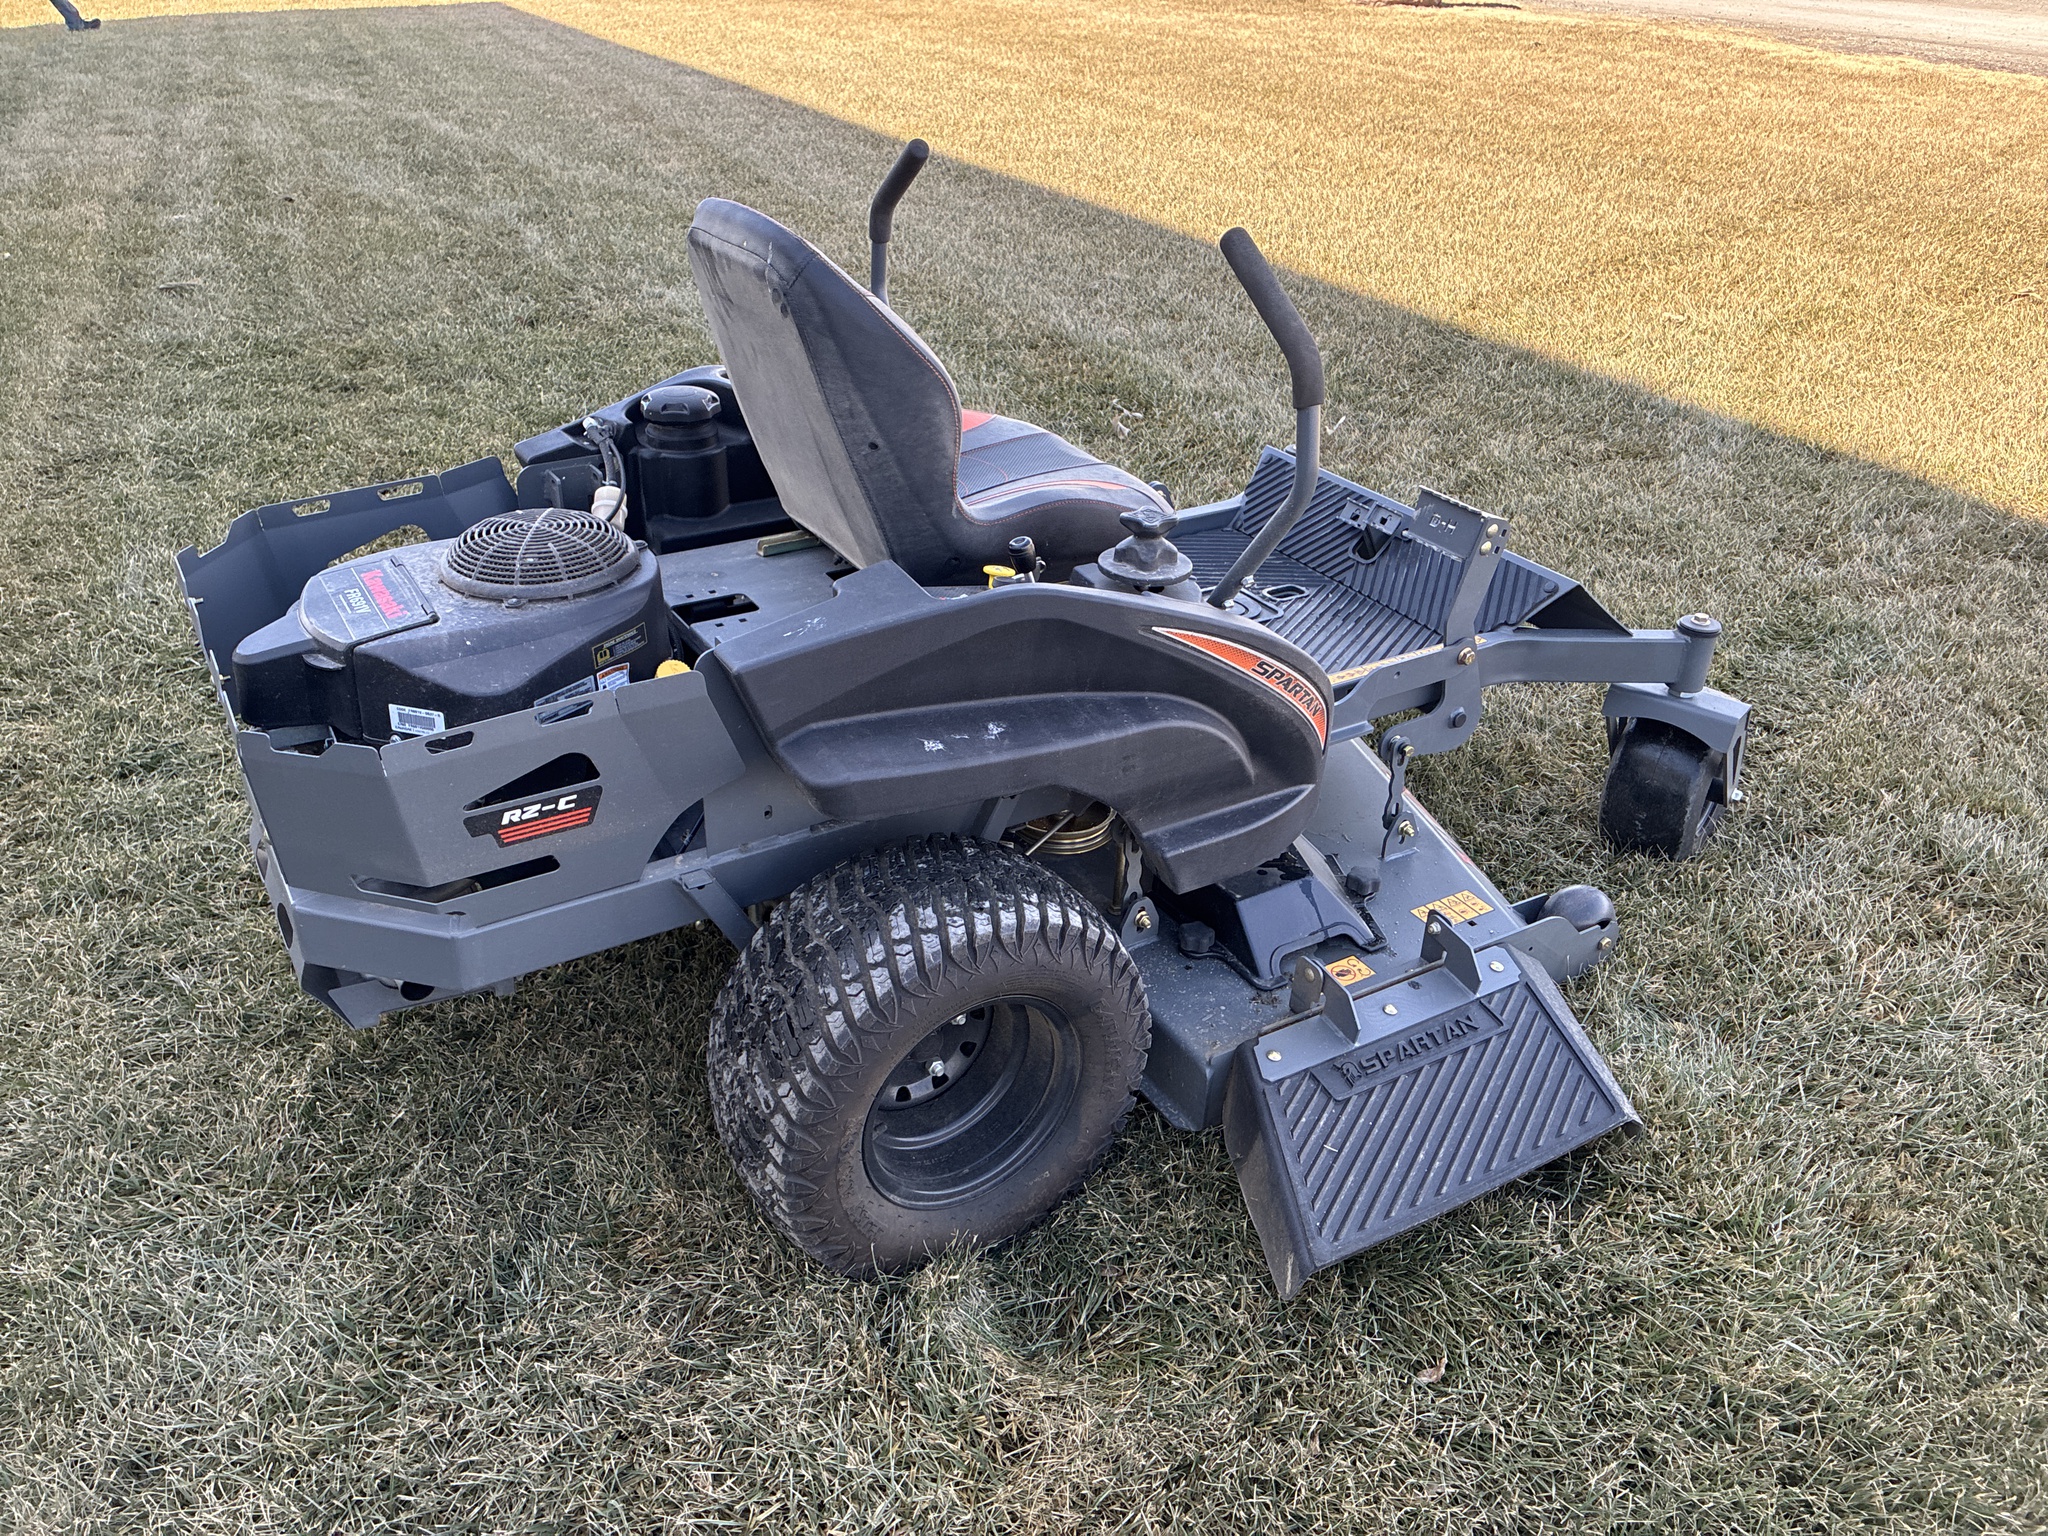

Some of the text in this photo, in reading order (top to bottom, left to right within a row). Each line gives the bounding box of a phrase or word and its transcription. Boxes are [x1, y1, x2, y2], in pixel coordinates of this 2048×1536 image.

[344, 588, 371, 614] FR691V
[360, 569, 409, 619] Kawasaki
[1251, 660, 1322, 718] SPARTAN
[501, 794, 577, 826] RZ-C
[1360, 1014, 1480, 1076] SPARTAN
